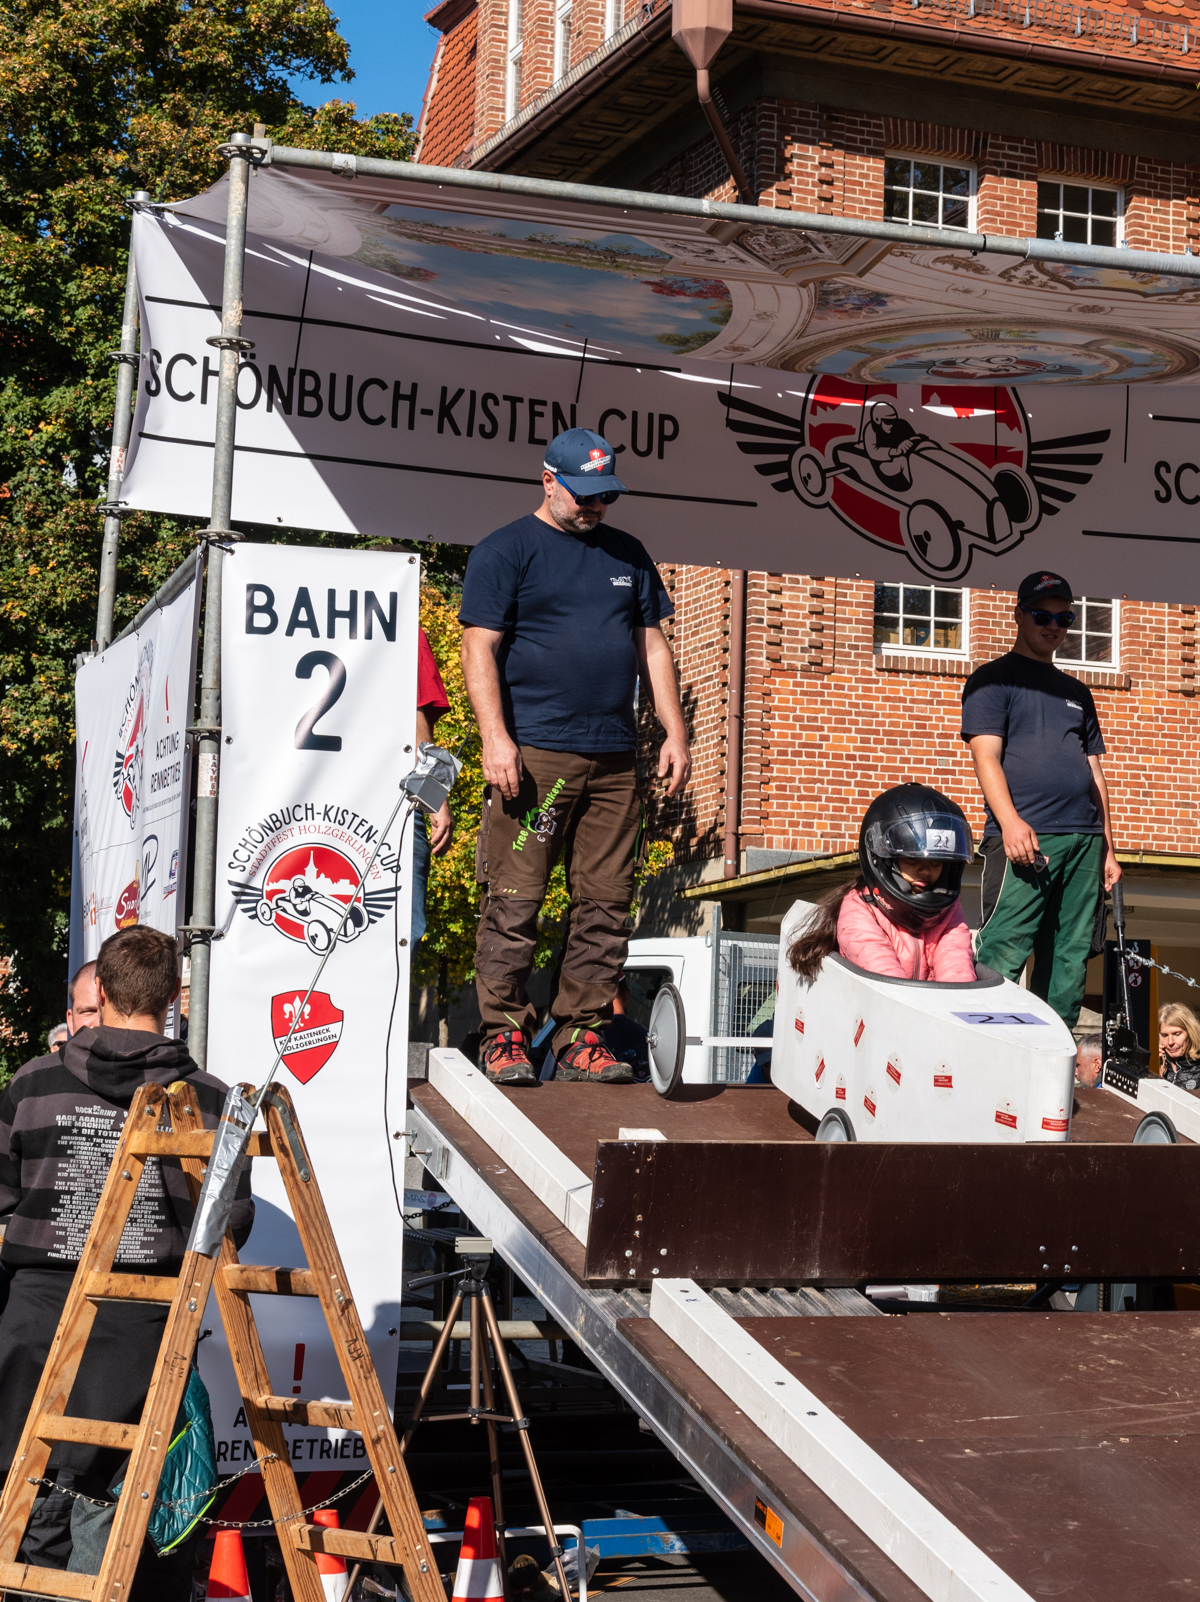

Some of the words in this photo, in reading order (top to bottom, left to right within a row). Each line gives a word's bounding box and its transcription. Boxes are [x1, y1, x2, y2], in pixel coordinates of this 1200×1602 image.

[145, 348, 680, 460] SCHÖNBUCH-KISTENCUP
[246, 583, 398, 642] BAHN
[294, 650, 347, 751] 2
[539, 778, 566, 812] onkeys
[228, 802, 402, 874] SCHÖNBUCH-KISTEN-CUP
[249, 827, 295, 877] STADTFEST
[298, 824, 382, 880] HOLZGERLINGEN
[512, 830, 529, 852] Tree
[934, 834, 949, 848] 21
[294, 1027, 331, 1042] KALTENECK
[968, 1013, 1036, 1025] 21
[216, 1438, 367, 1463] RENETRIEB
